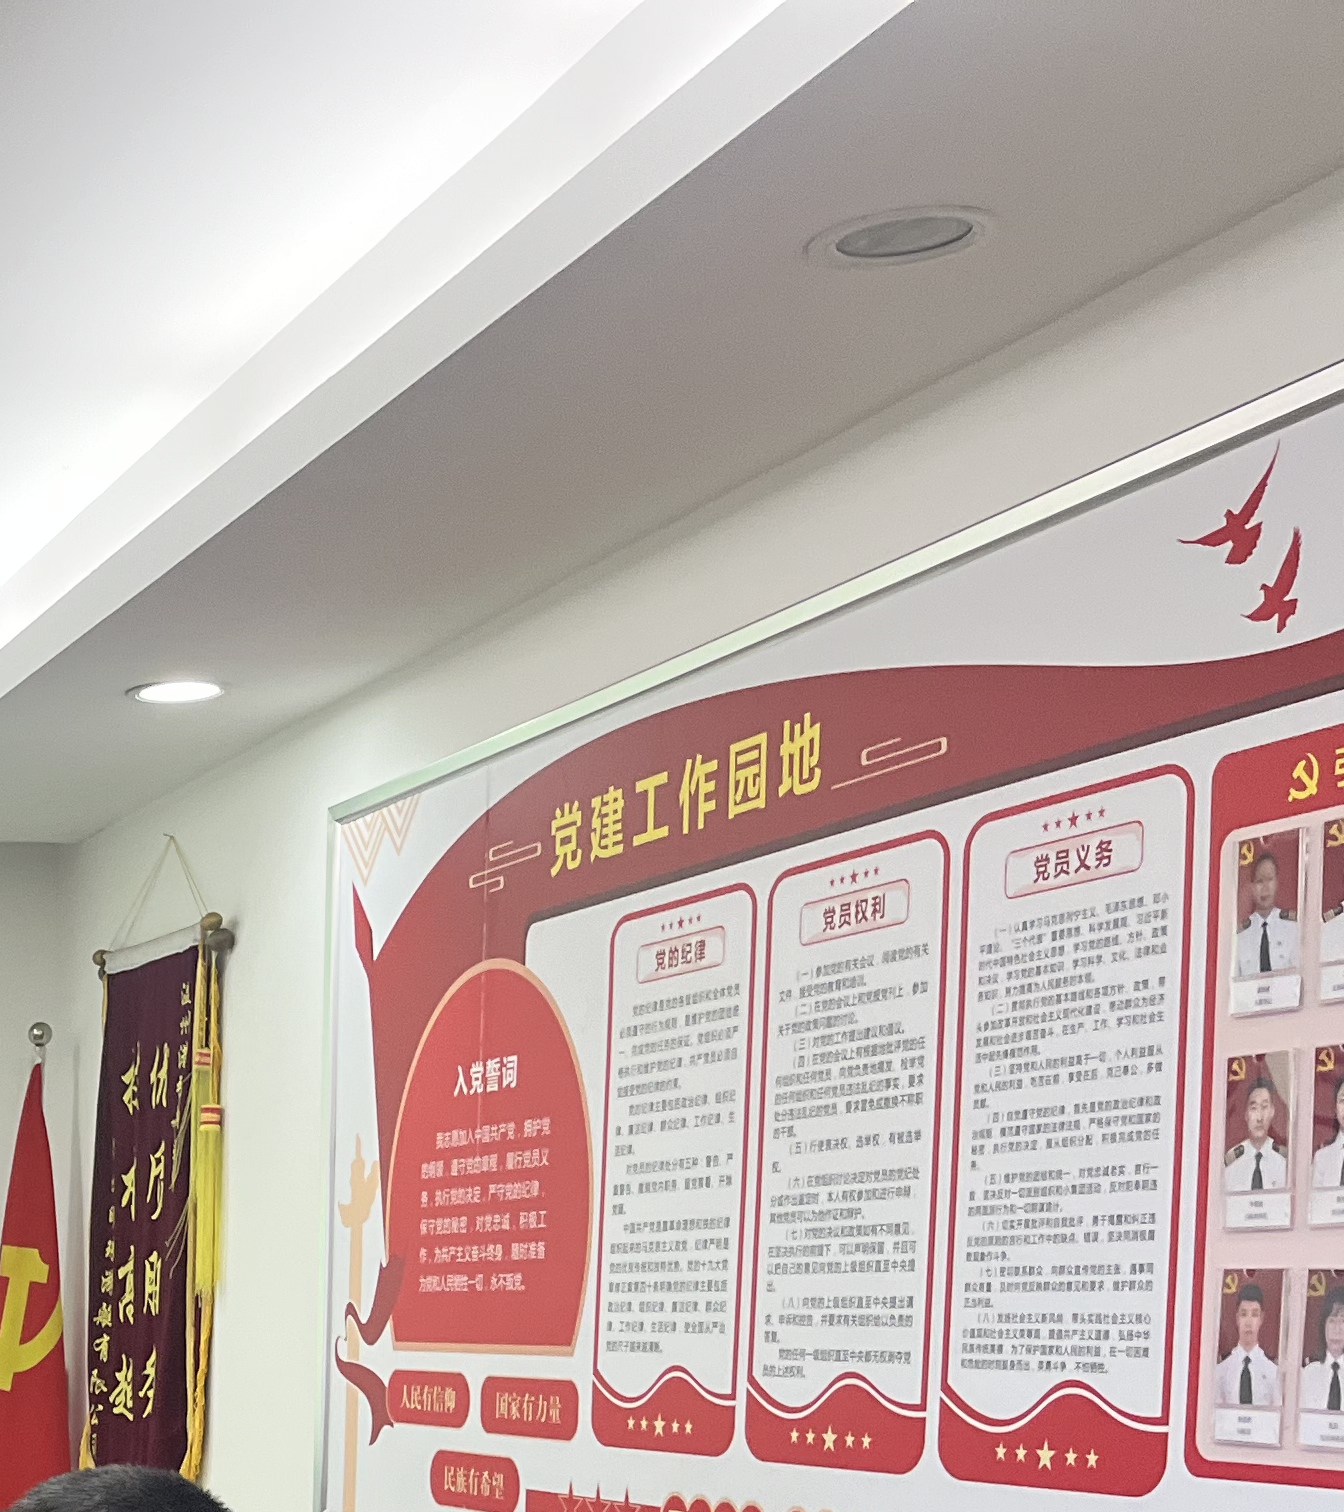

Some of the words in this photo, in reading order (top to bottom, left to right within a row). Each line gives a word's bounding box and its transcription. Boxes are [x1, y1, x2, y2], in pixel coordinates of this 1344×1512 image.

[550, 711, 821, 878] 党建工作园地
[1032, 839, 1114, 884] 党员义务
[822, 893, 886, 932] 党员权利
[654, 939, 706, 972] 党的纪律
[453, 1054, 519, 1098] 入党誓词
[400, 1384, 456, 1414] 人民有信仰
[495, 1391, 562, 1425] 国家有力量
[443, 1465, 505, 1500] 民族有希望
